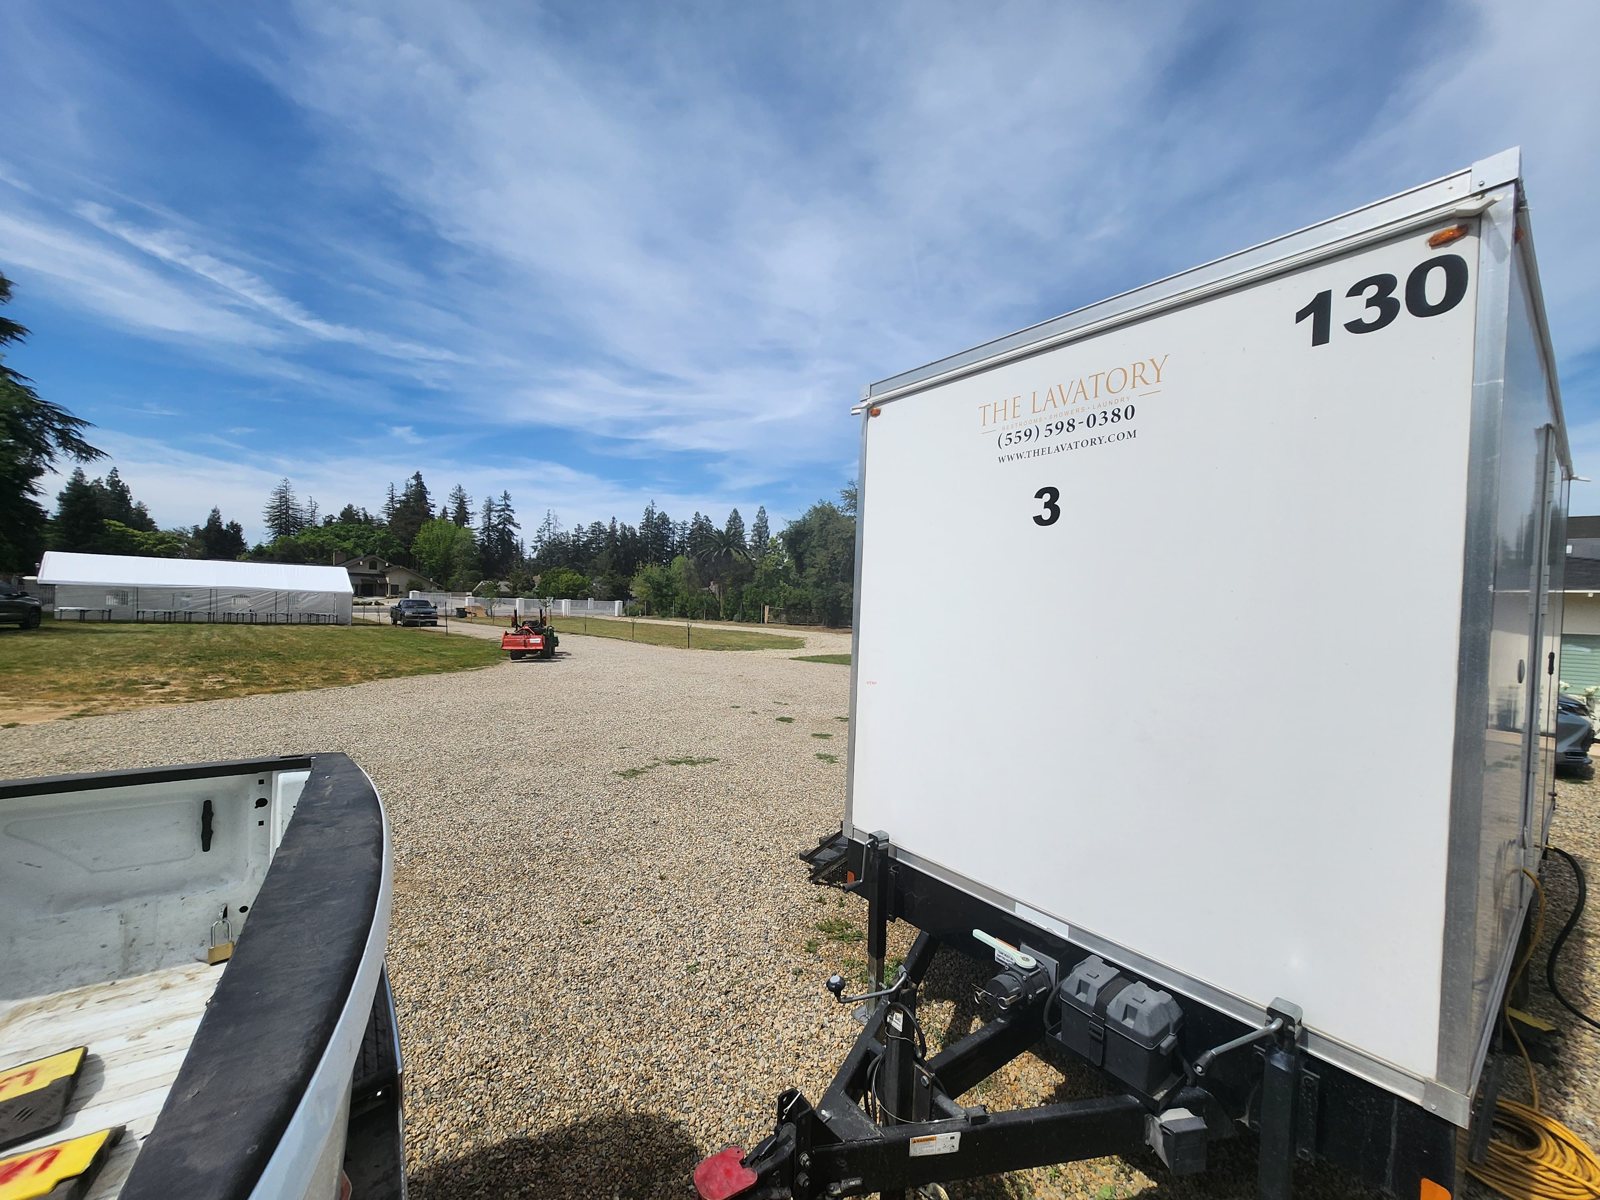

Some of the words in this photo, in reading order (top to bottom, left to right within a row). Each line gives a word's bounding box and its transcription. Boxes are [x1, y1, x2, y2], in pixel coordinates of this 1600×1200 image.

[1295, 253, 1469, 347] 130
[978, 395, 1021, 427] THE
[1032, 354, 1170, 414] LAVATORY
[997, 424, 1040, 449] (559)
[1044, 404, 1136, 438] 598-0380
[997, 429, 1137, 464] WWW.THELAVATORY.COM
[1032, 486, 1061, 526] 3
